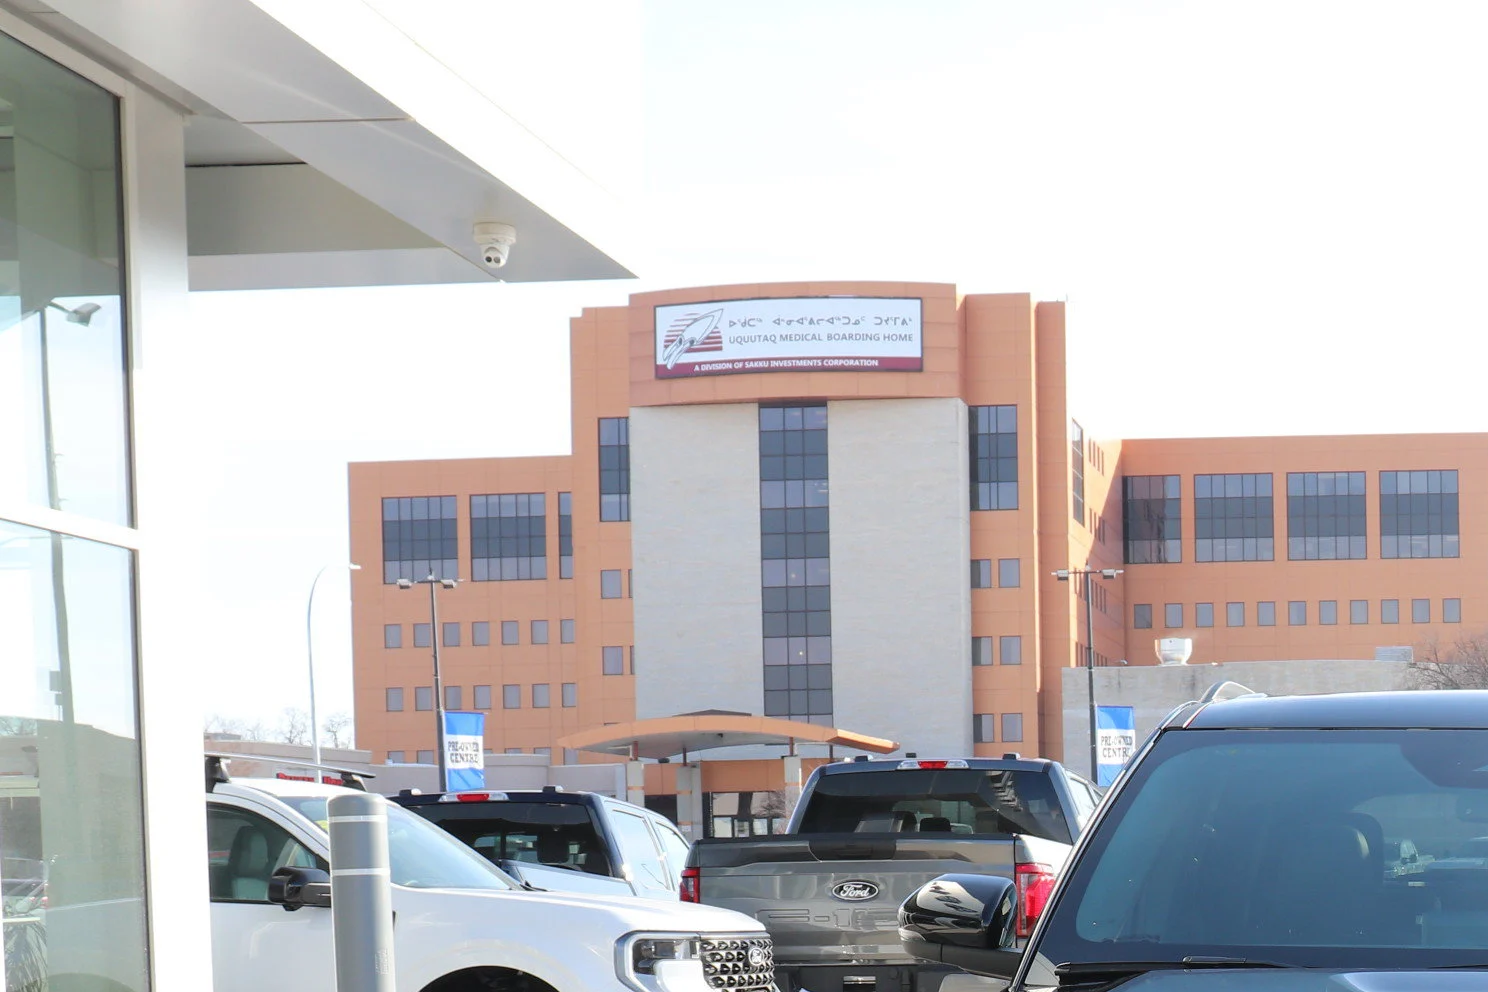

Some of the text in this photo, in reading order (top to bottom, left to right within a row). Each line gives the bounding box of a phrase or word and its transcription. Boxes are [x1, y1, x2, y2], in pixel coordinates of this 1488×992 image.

[728, 332, 913, 345] UQUUTAQ MEDICAL BOARDING HOME
[701, 363, 732, 371] DIVISION
[733, 361, 743, 369] OF
[744, 360, 769, 368] SAKKU
[770, 359, 822, 367] INVESTMENTS
[823, 359, 879, 367] CORPORATION
